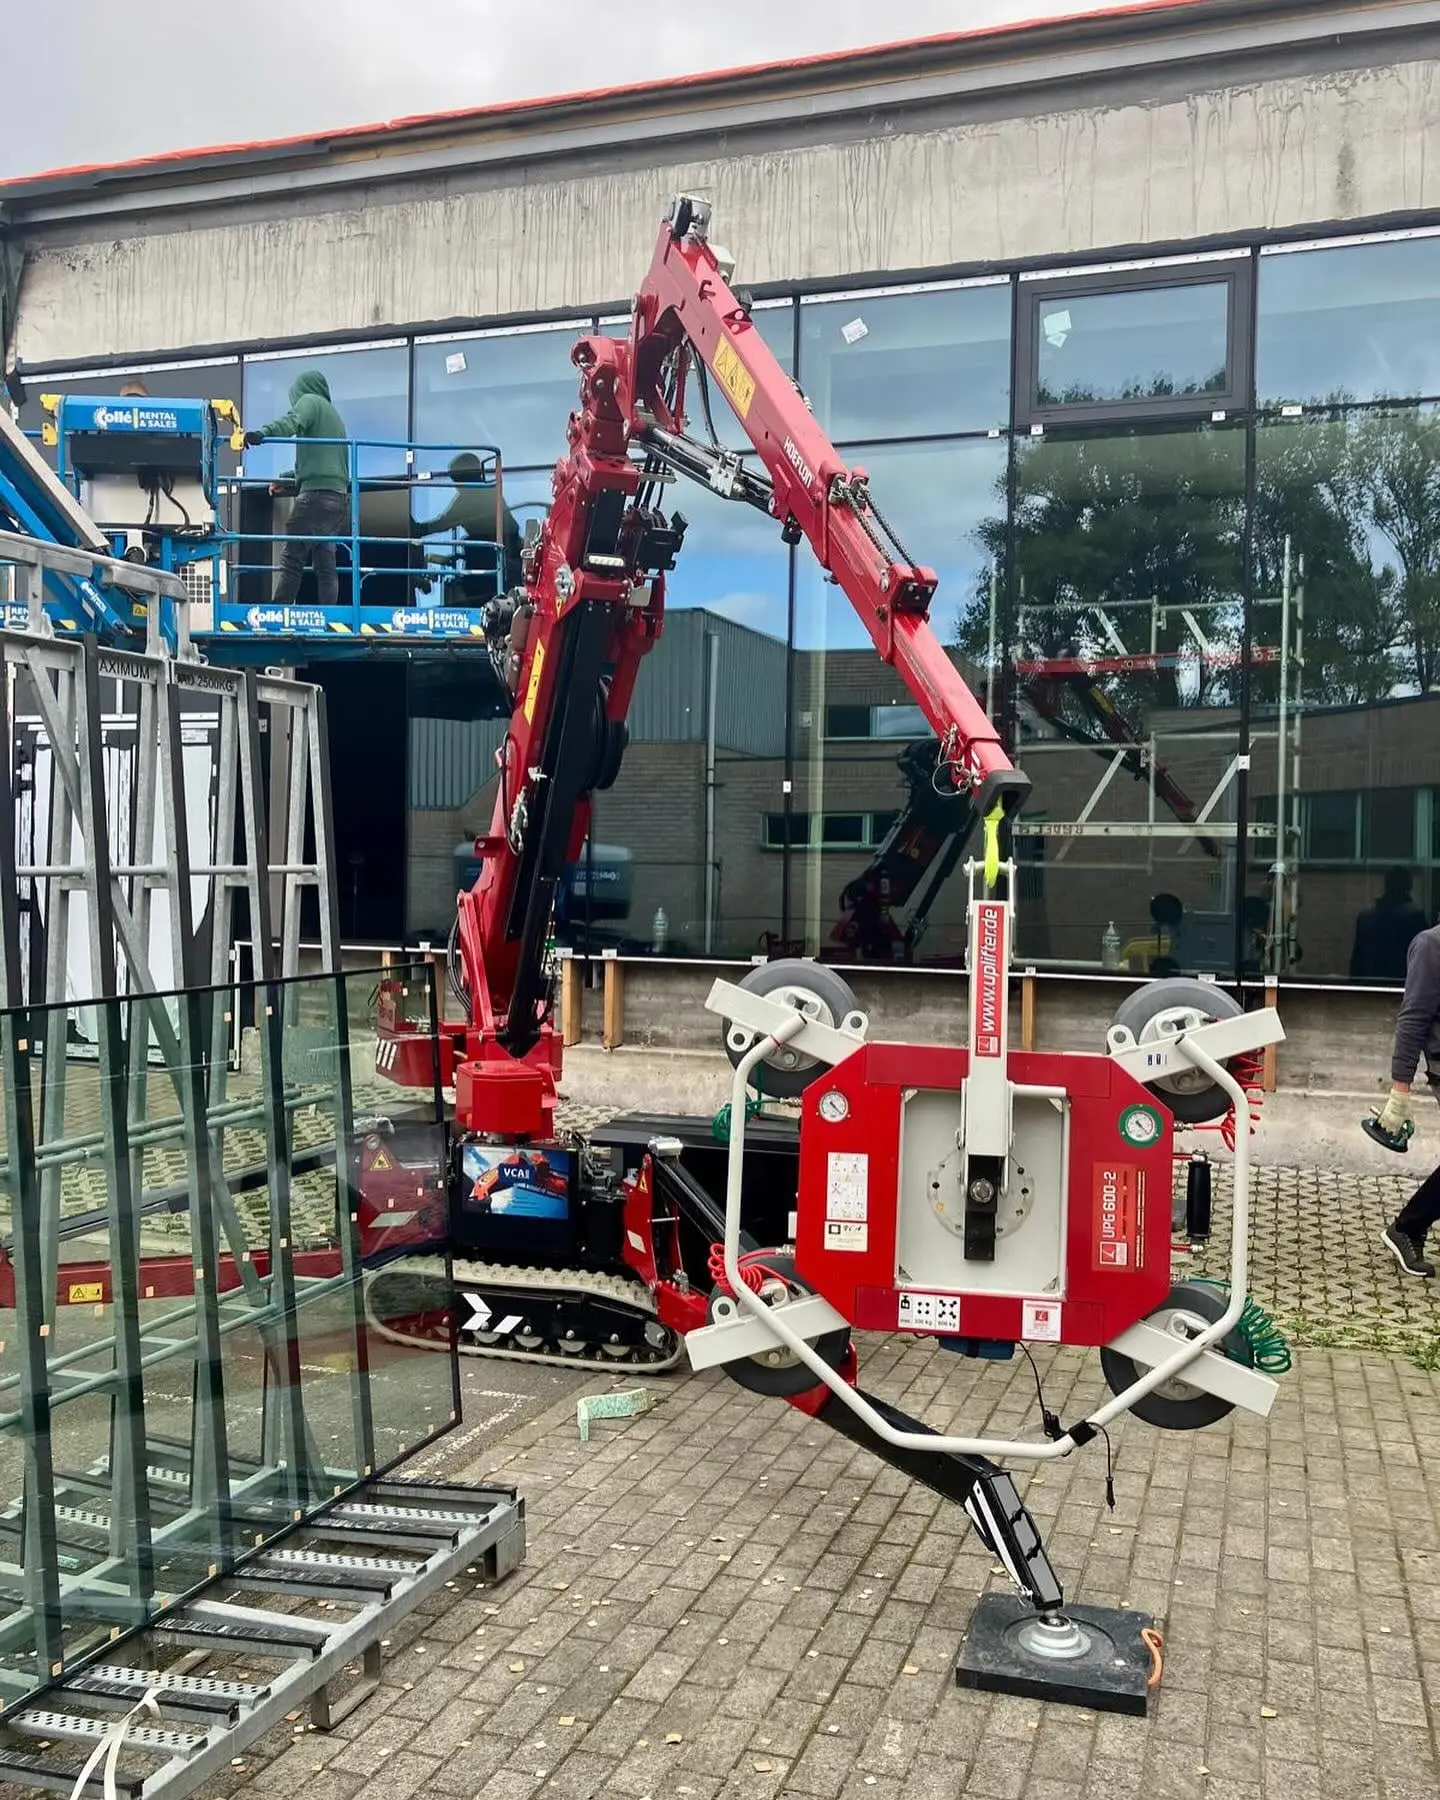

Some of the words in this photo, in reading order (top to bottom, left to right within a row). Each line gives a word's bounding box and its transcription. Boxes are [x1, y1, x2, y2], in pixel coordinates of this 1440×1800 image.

[94, 407, 132, 430] Collé
[140, 411, 176, 420] RENTAL
[140, 420, 147, 428] &
[148, 420, 177, 429] SALES
[783, 435, 813, 489] HOEFLON
[290, 611, 325, 619] RENTAL
[434, 613, 469, 622] RENTAL
[442, 621, 469, 629] SALES
[99, 659, 150, 680] AXIMUM
[197, 674, 233, 692] 2500KG
[980, 908, 1000, 1032] www.uplifter.de
[1102, 1171, 1117, 1211] 600-2
[1102, 1213, 1116, 1239] UPG
